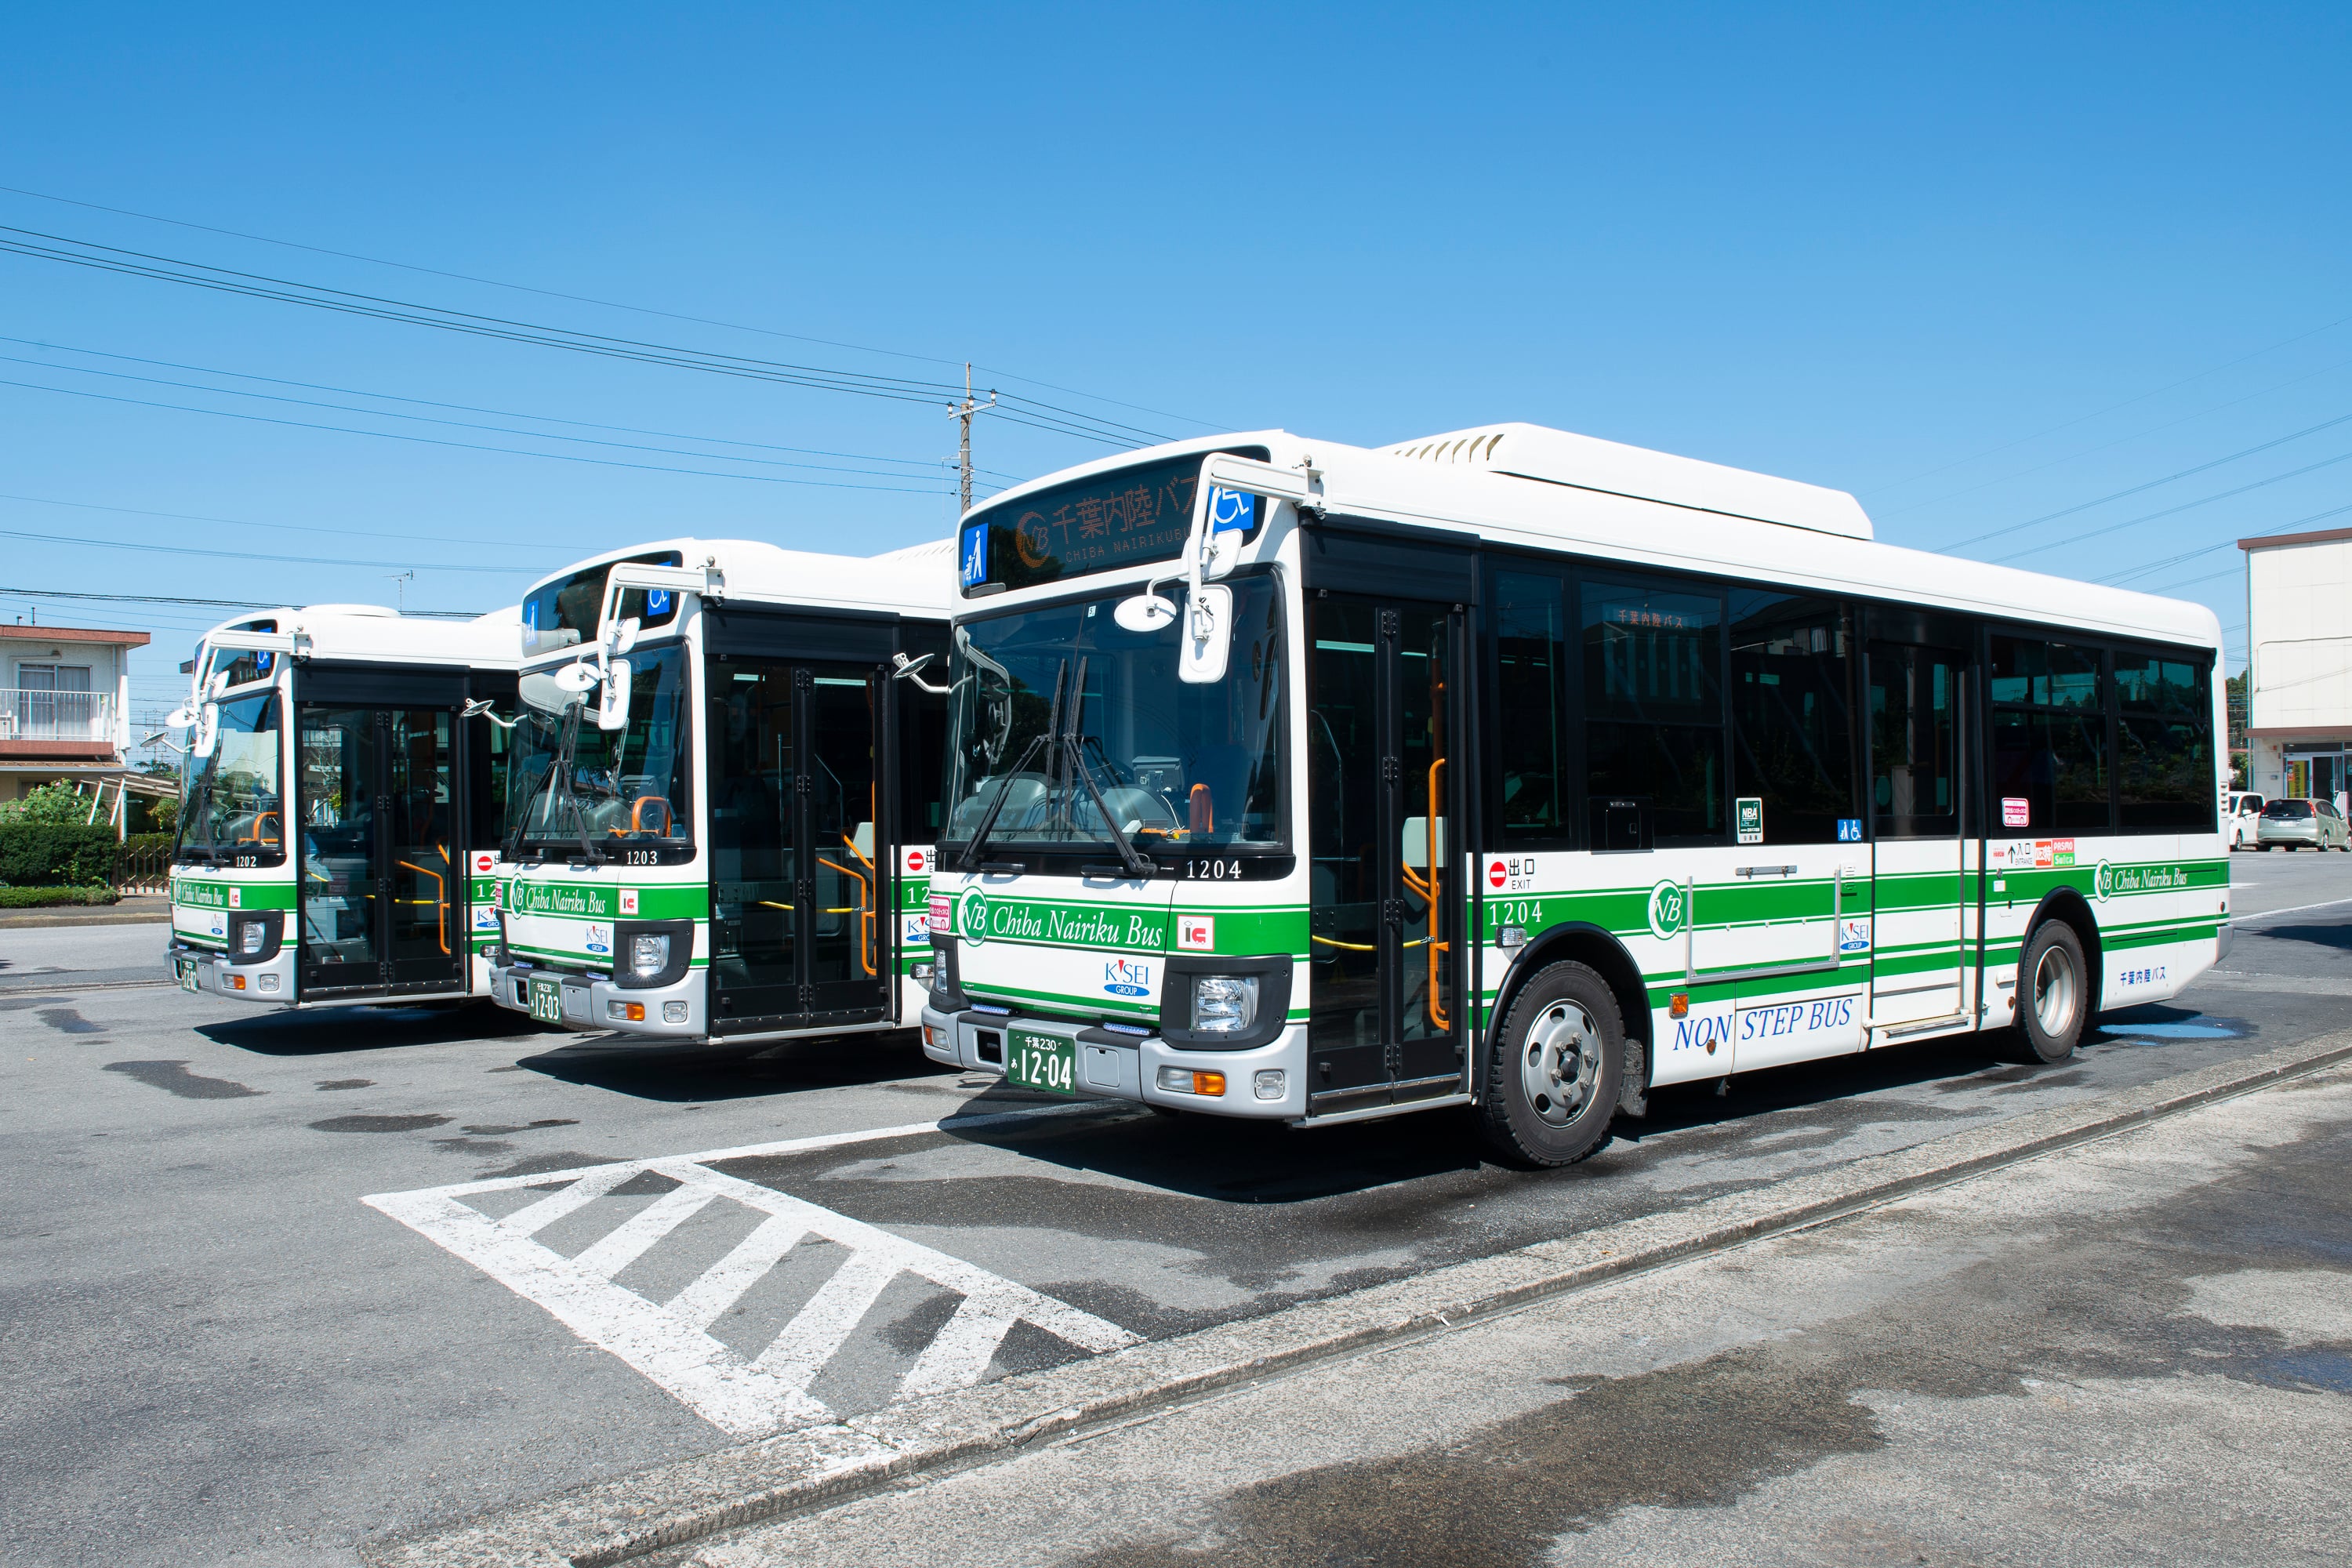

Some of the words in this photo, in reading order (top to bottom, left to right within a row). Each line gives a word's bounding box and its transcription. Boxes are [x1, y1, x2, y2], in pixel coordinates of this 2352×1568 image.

[1065, 545, 1105, 564] CHIBA
[1113, 526, 1192, 554] NAIRIKUBU
[1617, 608, 1684, 629] 千葉内陸バス
[1741, 807, 1758, 818] NBA
[2017, 843, 2031, 856] 入口
[2053, 841, 2074, 851] PASMO
[236, 855, 256, 867] 1202
[626, 851, 657, 866] 1203
[1508, 858, 1535, 876] 出口
[2054, 854, 2074, 865] Suica
[1185, 859, 1242, 879] 1204
[2114, 869, 2140, 891] Chiba
[2141, 866, 2172, 888] Nairiku
[2173, 867, 2188, 886] Bus
[1512, 880, 1533, 890] EXIT
[526, 887, 550, 909] Chiba
[551, 889, 586, 913] Nairiku
[588, 891, 606, 914] Bus
[1490, 900, 1543, 926] 1204
[993, 906, 1042, 936] Chiba
[1046, 909, 1120, 943] Nairiku
[1126, 915, 1163, 947] Bus
[2120, 966, 2166, 987] 千葉内陸バス
[1116, 985, 1138, 996] GROUP
[1673, 1014, 1733, 1051] NON
[1741, 1004, 1804, 1040] STEP
[1808, 998, 1853, 1030] BUS
[1011, 1058, 1018, 1070] あ
[1021, 1047, 1072, 1091] 12-04
